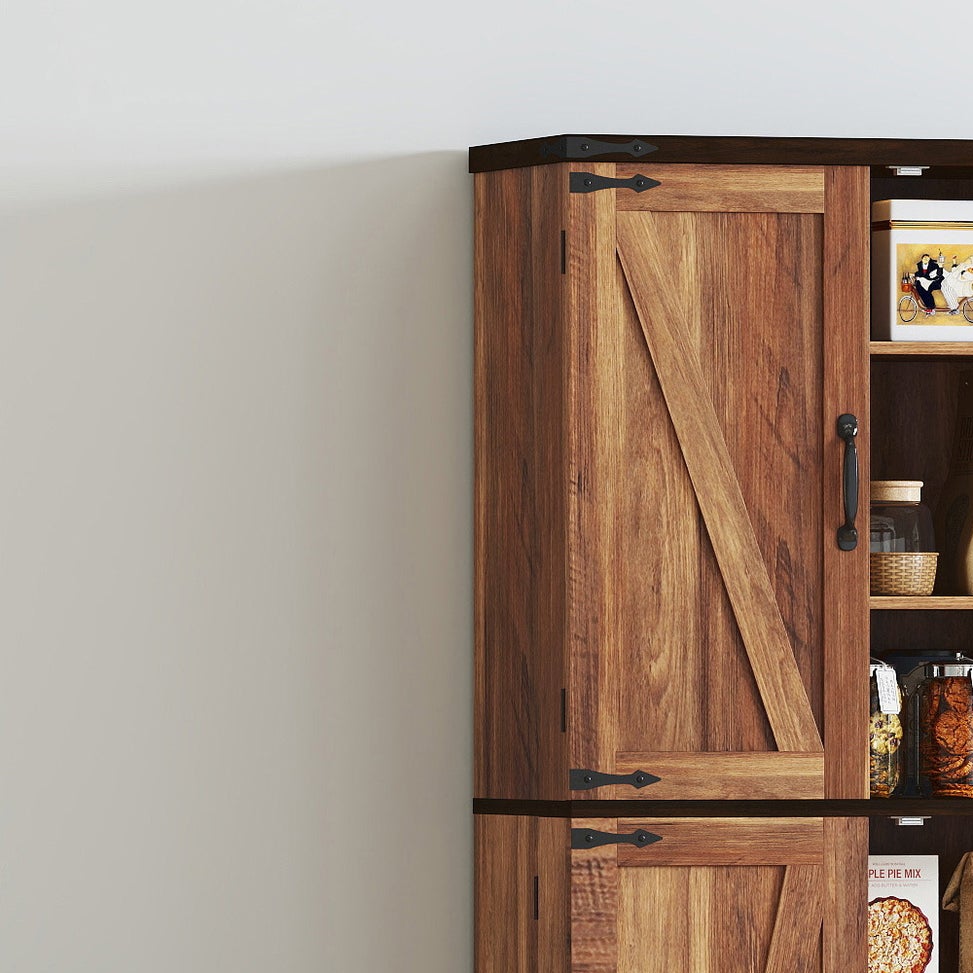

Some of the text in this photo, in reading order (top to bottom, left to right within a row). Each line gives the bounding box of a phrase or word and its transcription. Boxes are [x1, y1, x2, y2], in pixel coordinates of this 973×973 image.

[868, 869, 921, 878] PLE PIE MIX
